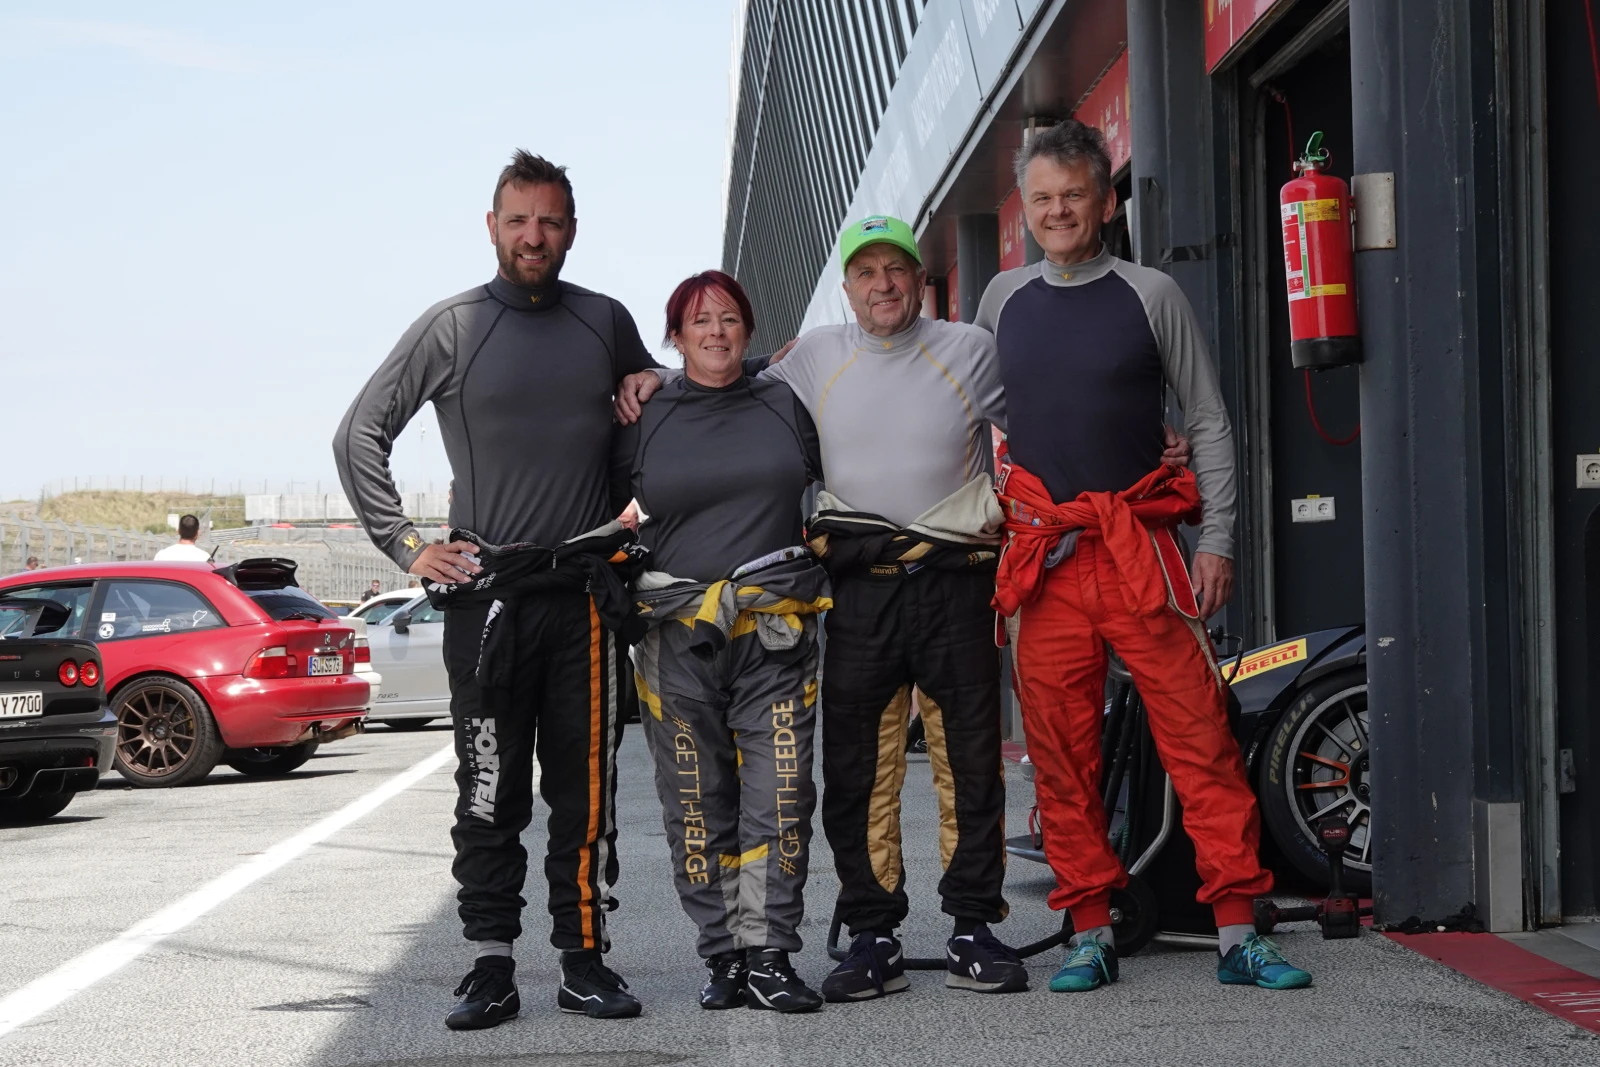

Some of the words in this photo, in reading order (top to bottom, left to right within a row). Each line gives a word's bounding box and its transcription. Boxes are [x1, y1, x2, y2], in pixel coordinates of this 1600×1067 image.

[1228, 644, 1298, 678] PIRELLI
[12, 694, 41, 714] 7700
[1269, 701, 1311, 785] PIRELLI
[671, 715, 709, 885] #GETTHEEDGE
[772, 699, 800, 876] #GETTHEEDGE
